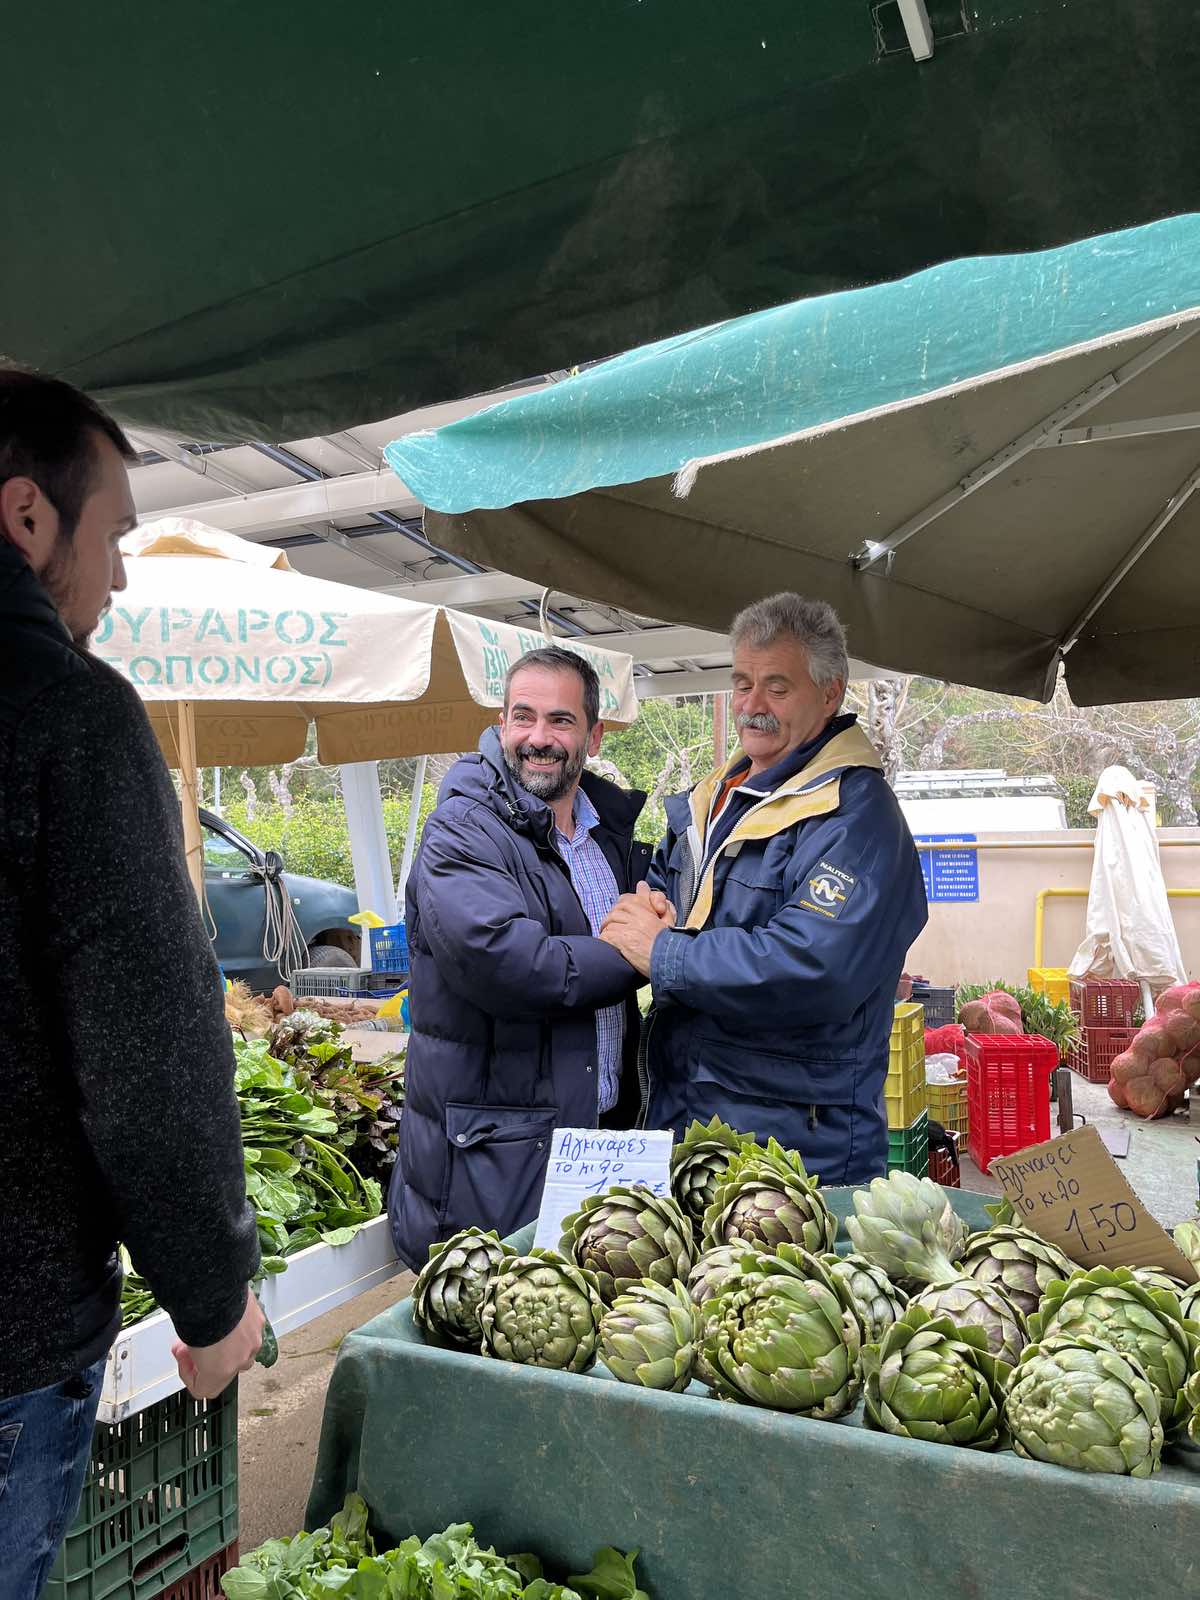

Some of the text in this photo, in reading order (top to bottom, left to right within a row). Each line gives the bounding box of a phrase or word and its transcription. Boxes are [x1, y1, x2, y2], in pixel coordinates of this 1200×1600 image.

[820, 861, 855, 885] NAUTICA
[559, 1132, 648, 1161] Αγκιναρες
[1064, 1202, 1137, 1253] 1,50
